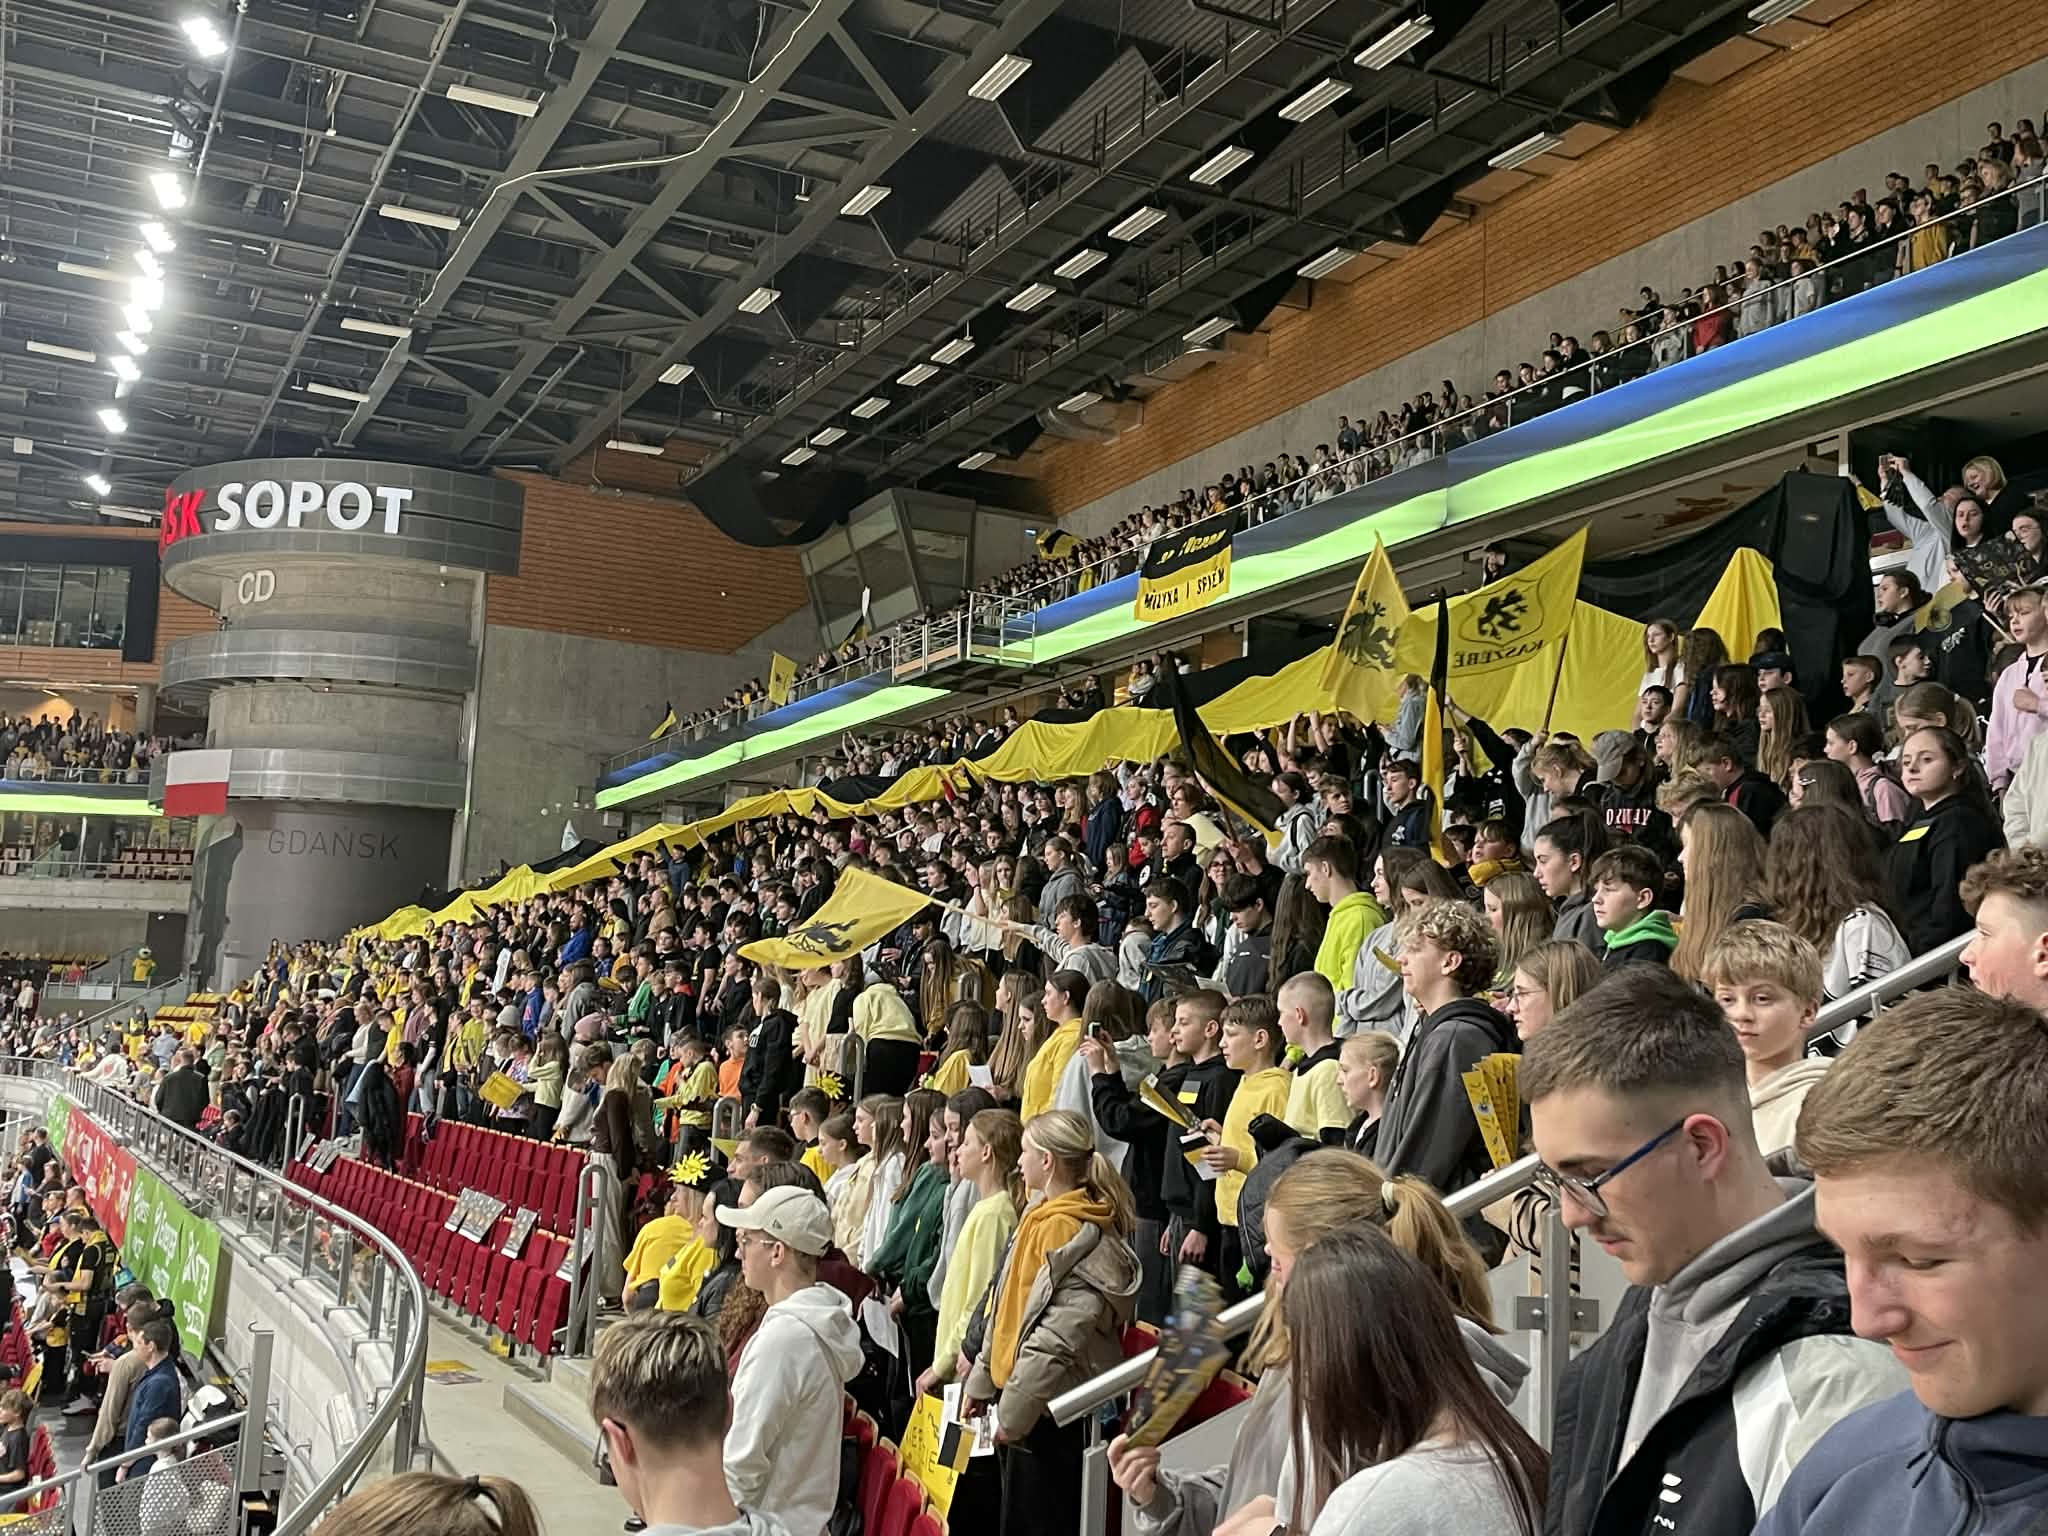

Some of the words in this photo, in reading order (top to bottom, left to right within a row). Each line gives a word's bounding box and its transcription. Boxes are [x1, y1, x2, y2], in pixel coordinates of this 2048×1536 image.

[158, 487, 206, 559] SK
[214, 480, 413, 535] SOPOT
[238, 569, 276, 604] CD
[268, 826, 399, 860] GDAŃSK
